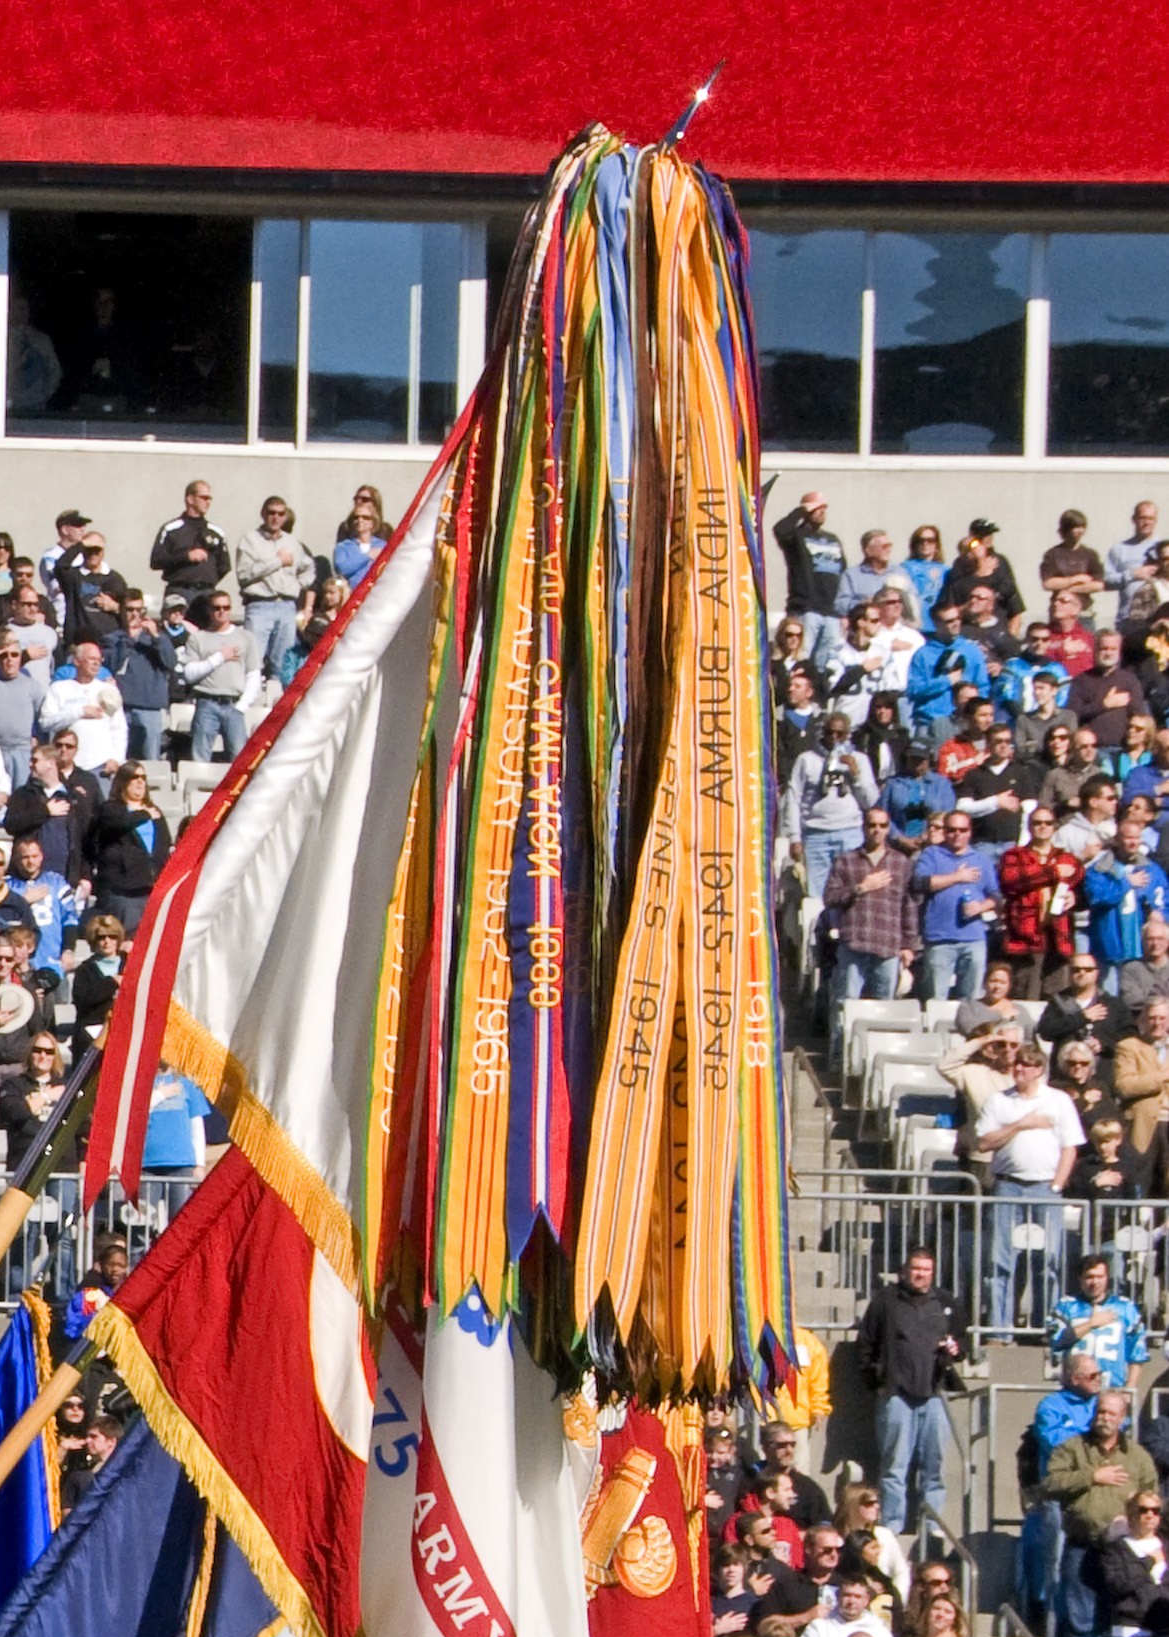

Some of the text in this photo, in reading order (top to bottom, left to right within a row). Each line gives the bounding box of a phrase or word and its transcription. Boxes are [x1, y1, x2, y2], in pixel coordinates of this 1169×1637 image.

[617, 978, 661, 1092] 1945
[745, 980, 768, 1069] 1918
[372, 1384, 420, 1478] 75
